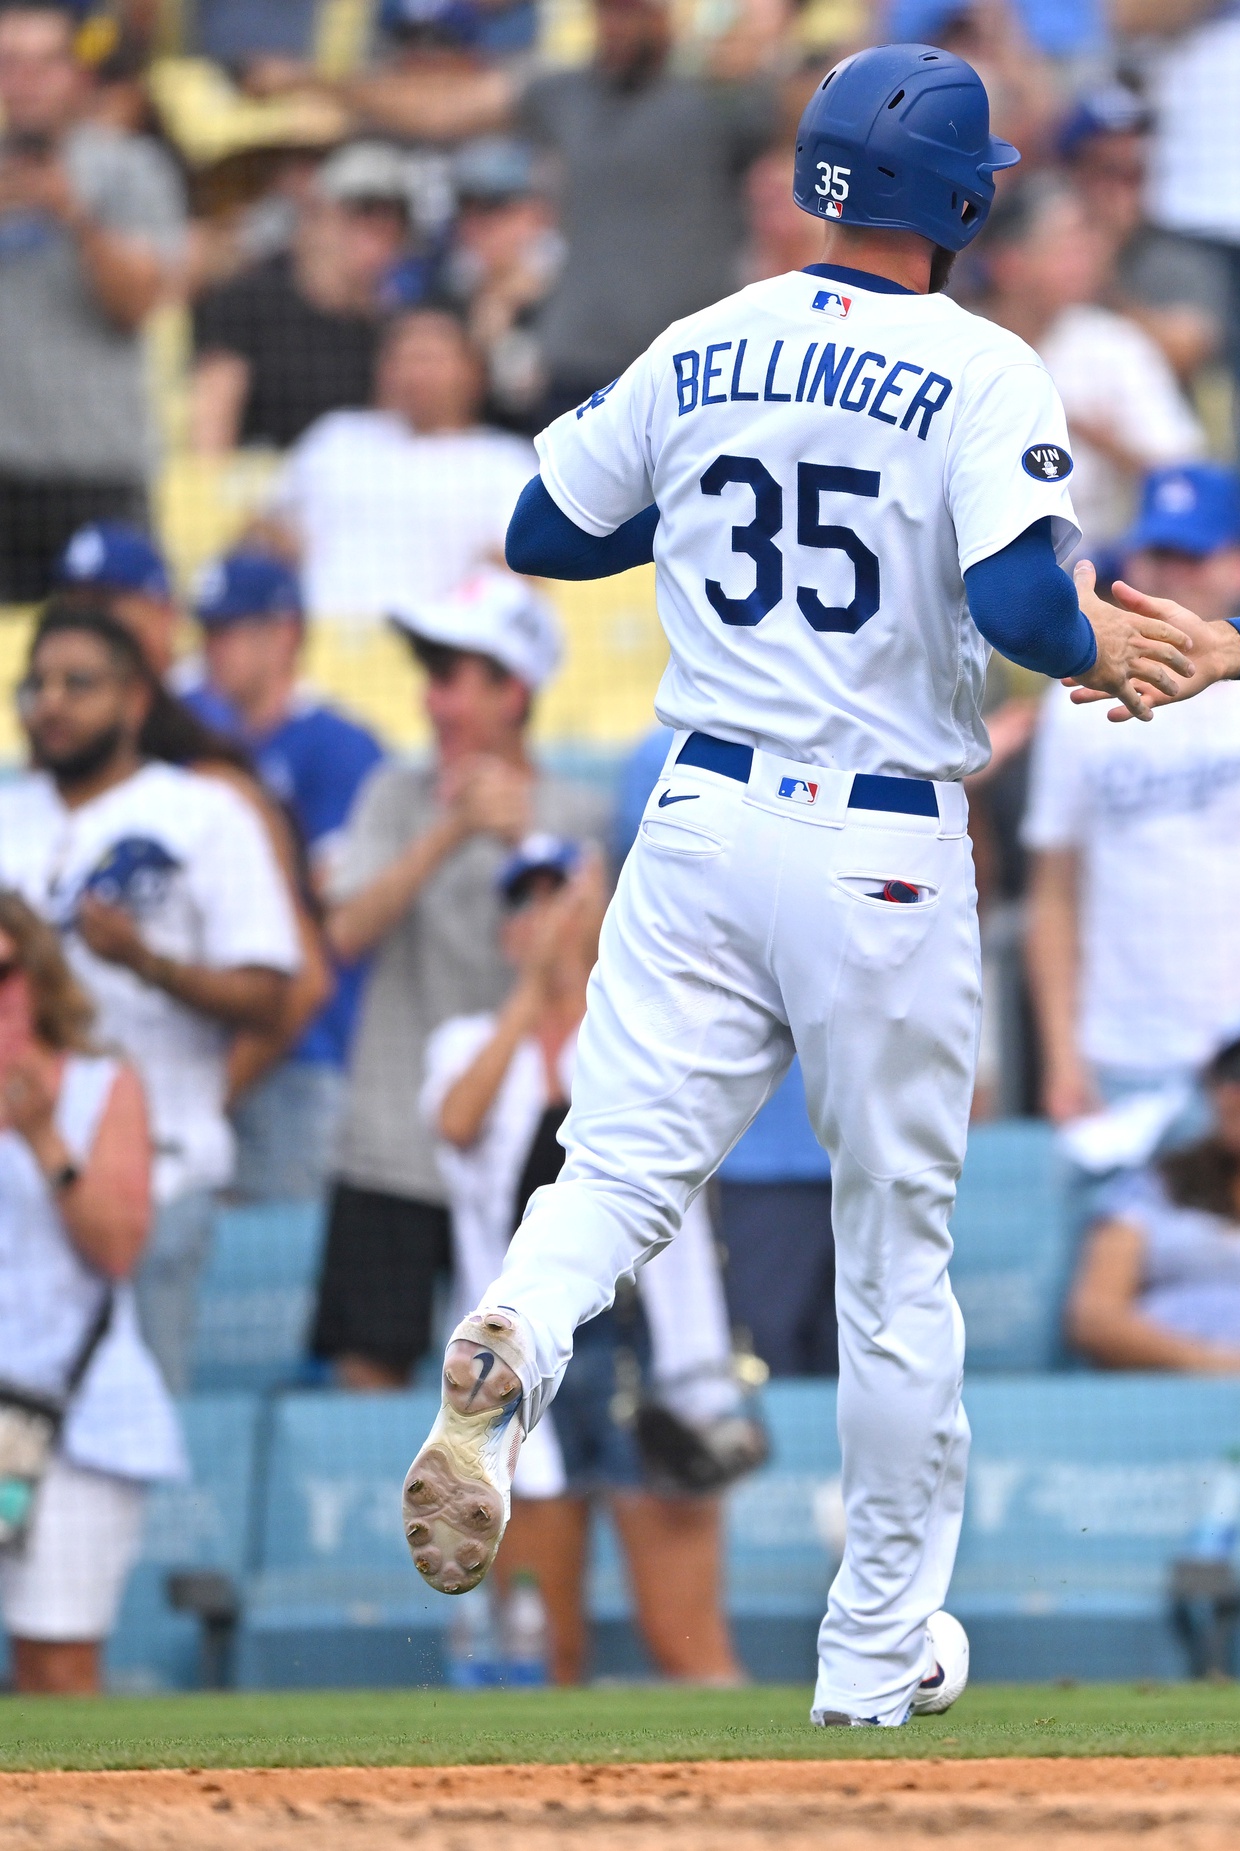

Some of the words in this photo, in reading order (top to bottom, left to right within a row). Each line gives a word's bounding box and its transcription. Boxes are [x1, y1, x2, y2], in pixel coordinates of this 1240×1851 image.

[815, 161, 851, 201] 35
[672, 339, 953, 441] BELLINGER
[1030, 448, 1060, 463] VIN
[700, 454, 881, 634] 35
